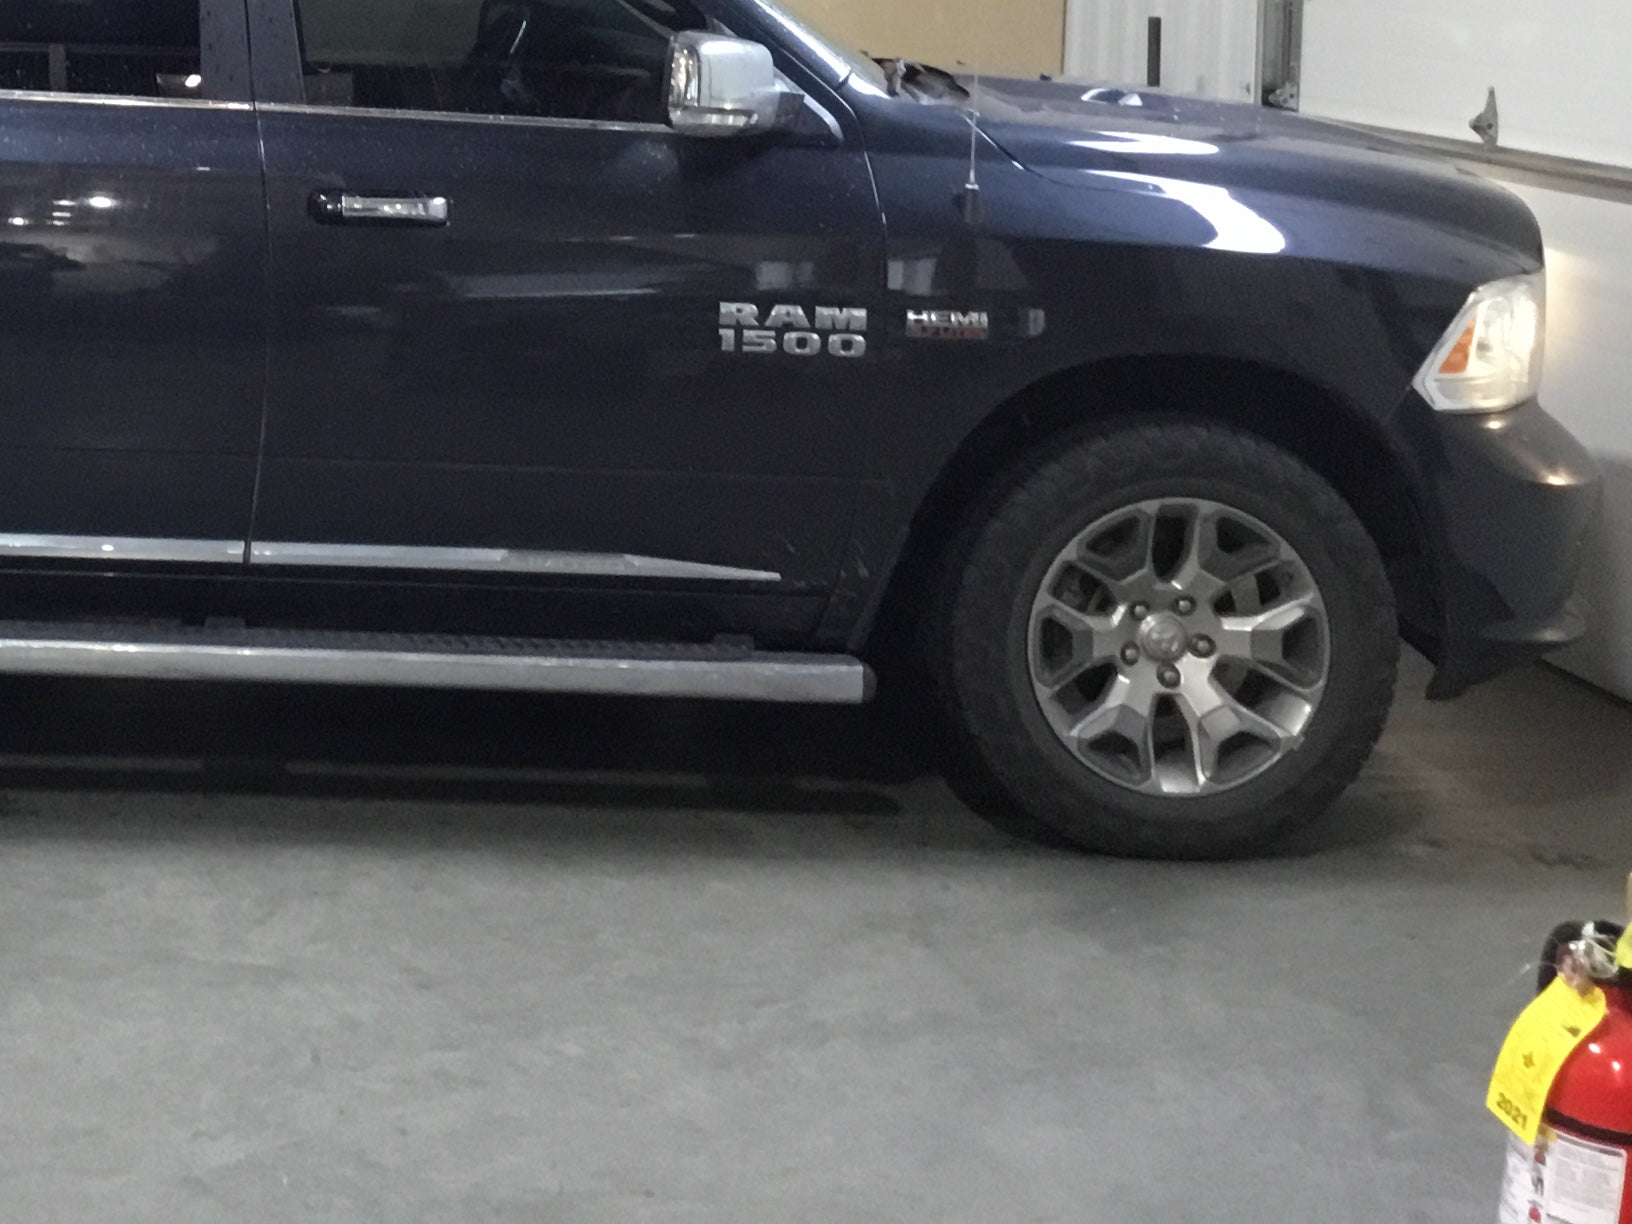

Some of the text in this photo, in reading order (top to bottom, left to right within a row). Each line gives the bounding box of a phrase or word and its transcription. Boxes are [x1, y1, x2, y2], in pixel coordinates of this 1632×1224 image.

[719, 301, 867, 330] RAM
[906, 309, 988, 329] HEMI
[718, 327, 867, 357] 1500
[1496, 1092, 1528, 1129] 2021
